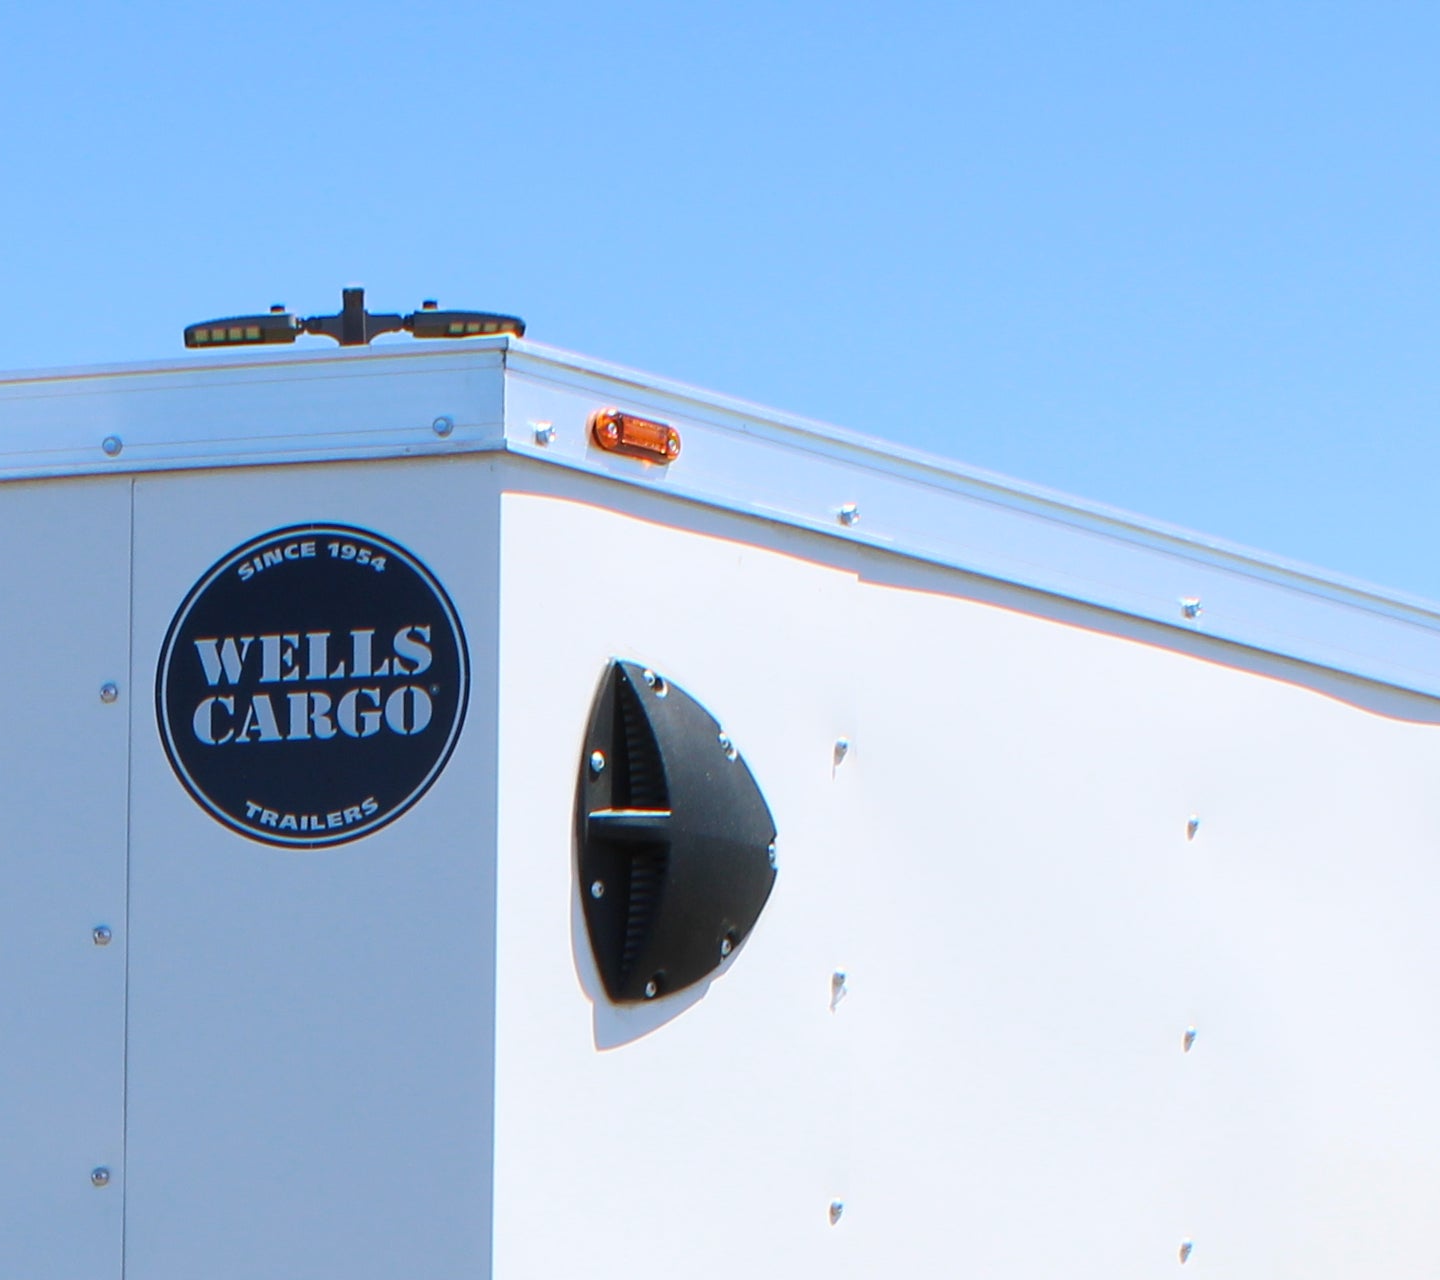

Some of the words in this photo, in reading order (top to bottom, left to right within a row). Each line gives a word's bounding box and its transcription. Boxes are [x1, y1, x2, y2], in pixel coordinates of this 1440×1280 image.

[237, 540, 317, 582] SINCE
[327, 541, 388, 574] 1954
[193, 624, 433, 687] WELLS
[192, 685, 433, 746] CARGO
[244, 796, 380, 831] TRAILERS
